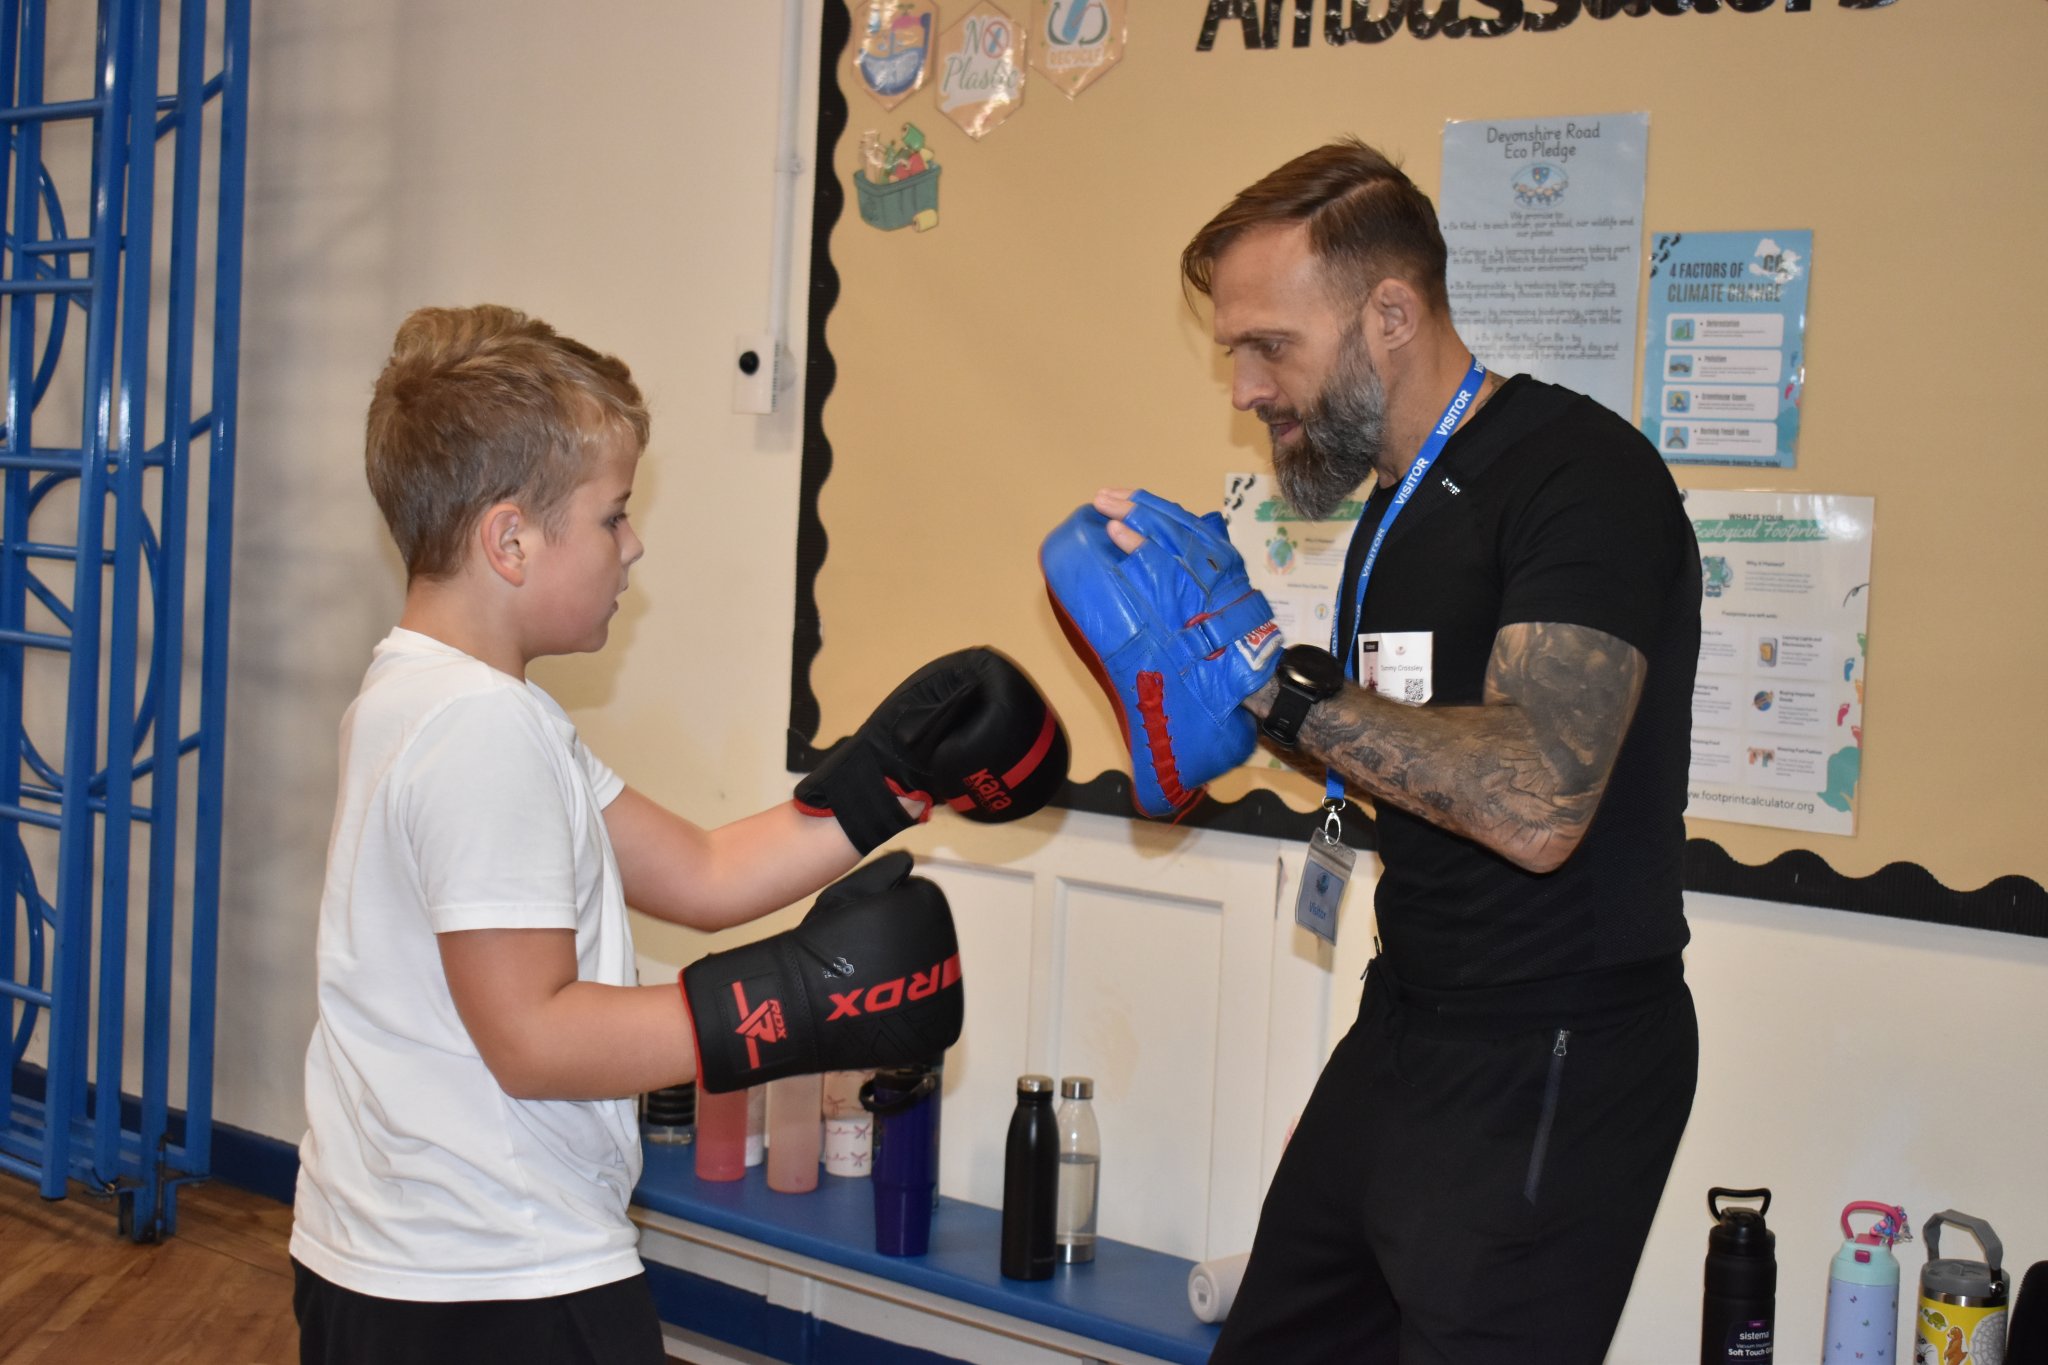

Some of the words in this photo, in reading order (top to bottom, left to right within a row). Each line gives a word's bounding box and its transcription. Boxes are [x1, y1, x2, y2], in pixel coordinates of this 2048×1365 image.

[943, 56, 1019, 92] Plastic
[1487, 127, 1561, 144] Devonshire
[1566, 123, 1600, 139] Road
[1504, 144, 1527, 159] Eco
[1532, 142, 1576, 162] Pledge
[1669, 263, 1677, 277] 4
[1679, 262, 1728, 278] FACTORS
[1730, 262, 1745, 278] OF
[1667, 283, 1724, 303] CLIMATE
[1726, 283, 1783, 302] CHANGE
[1436, 390, 1472, 436] VISITOR
[1395, 457, 1430, 505] VISITOR
[1729, 513, 1752, 521] WHAT
[1763, 521, 1827, 543] Footprin
[1362, 528, 1385, 577] VISITOR
[969, 768, 1012, 811] Kara
[1688, 790, 1815, 814] w.footprintcalculator.org
[825, 963, 941, 1021] RDX
[1728, 1348, 1744, 1357] Soft
[1745, 1348, 1766, 1357] Touch
